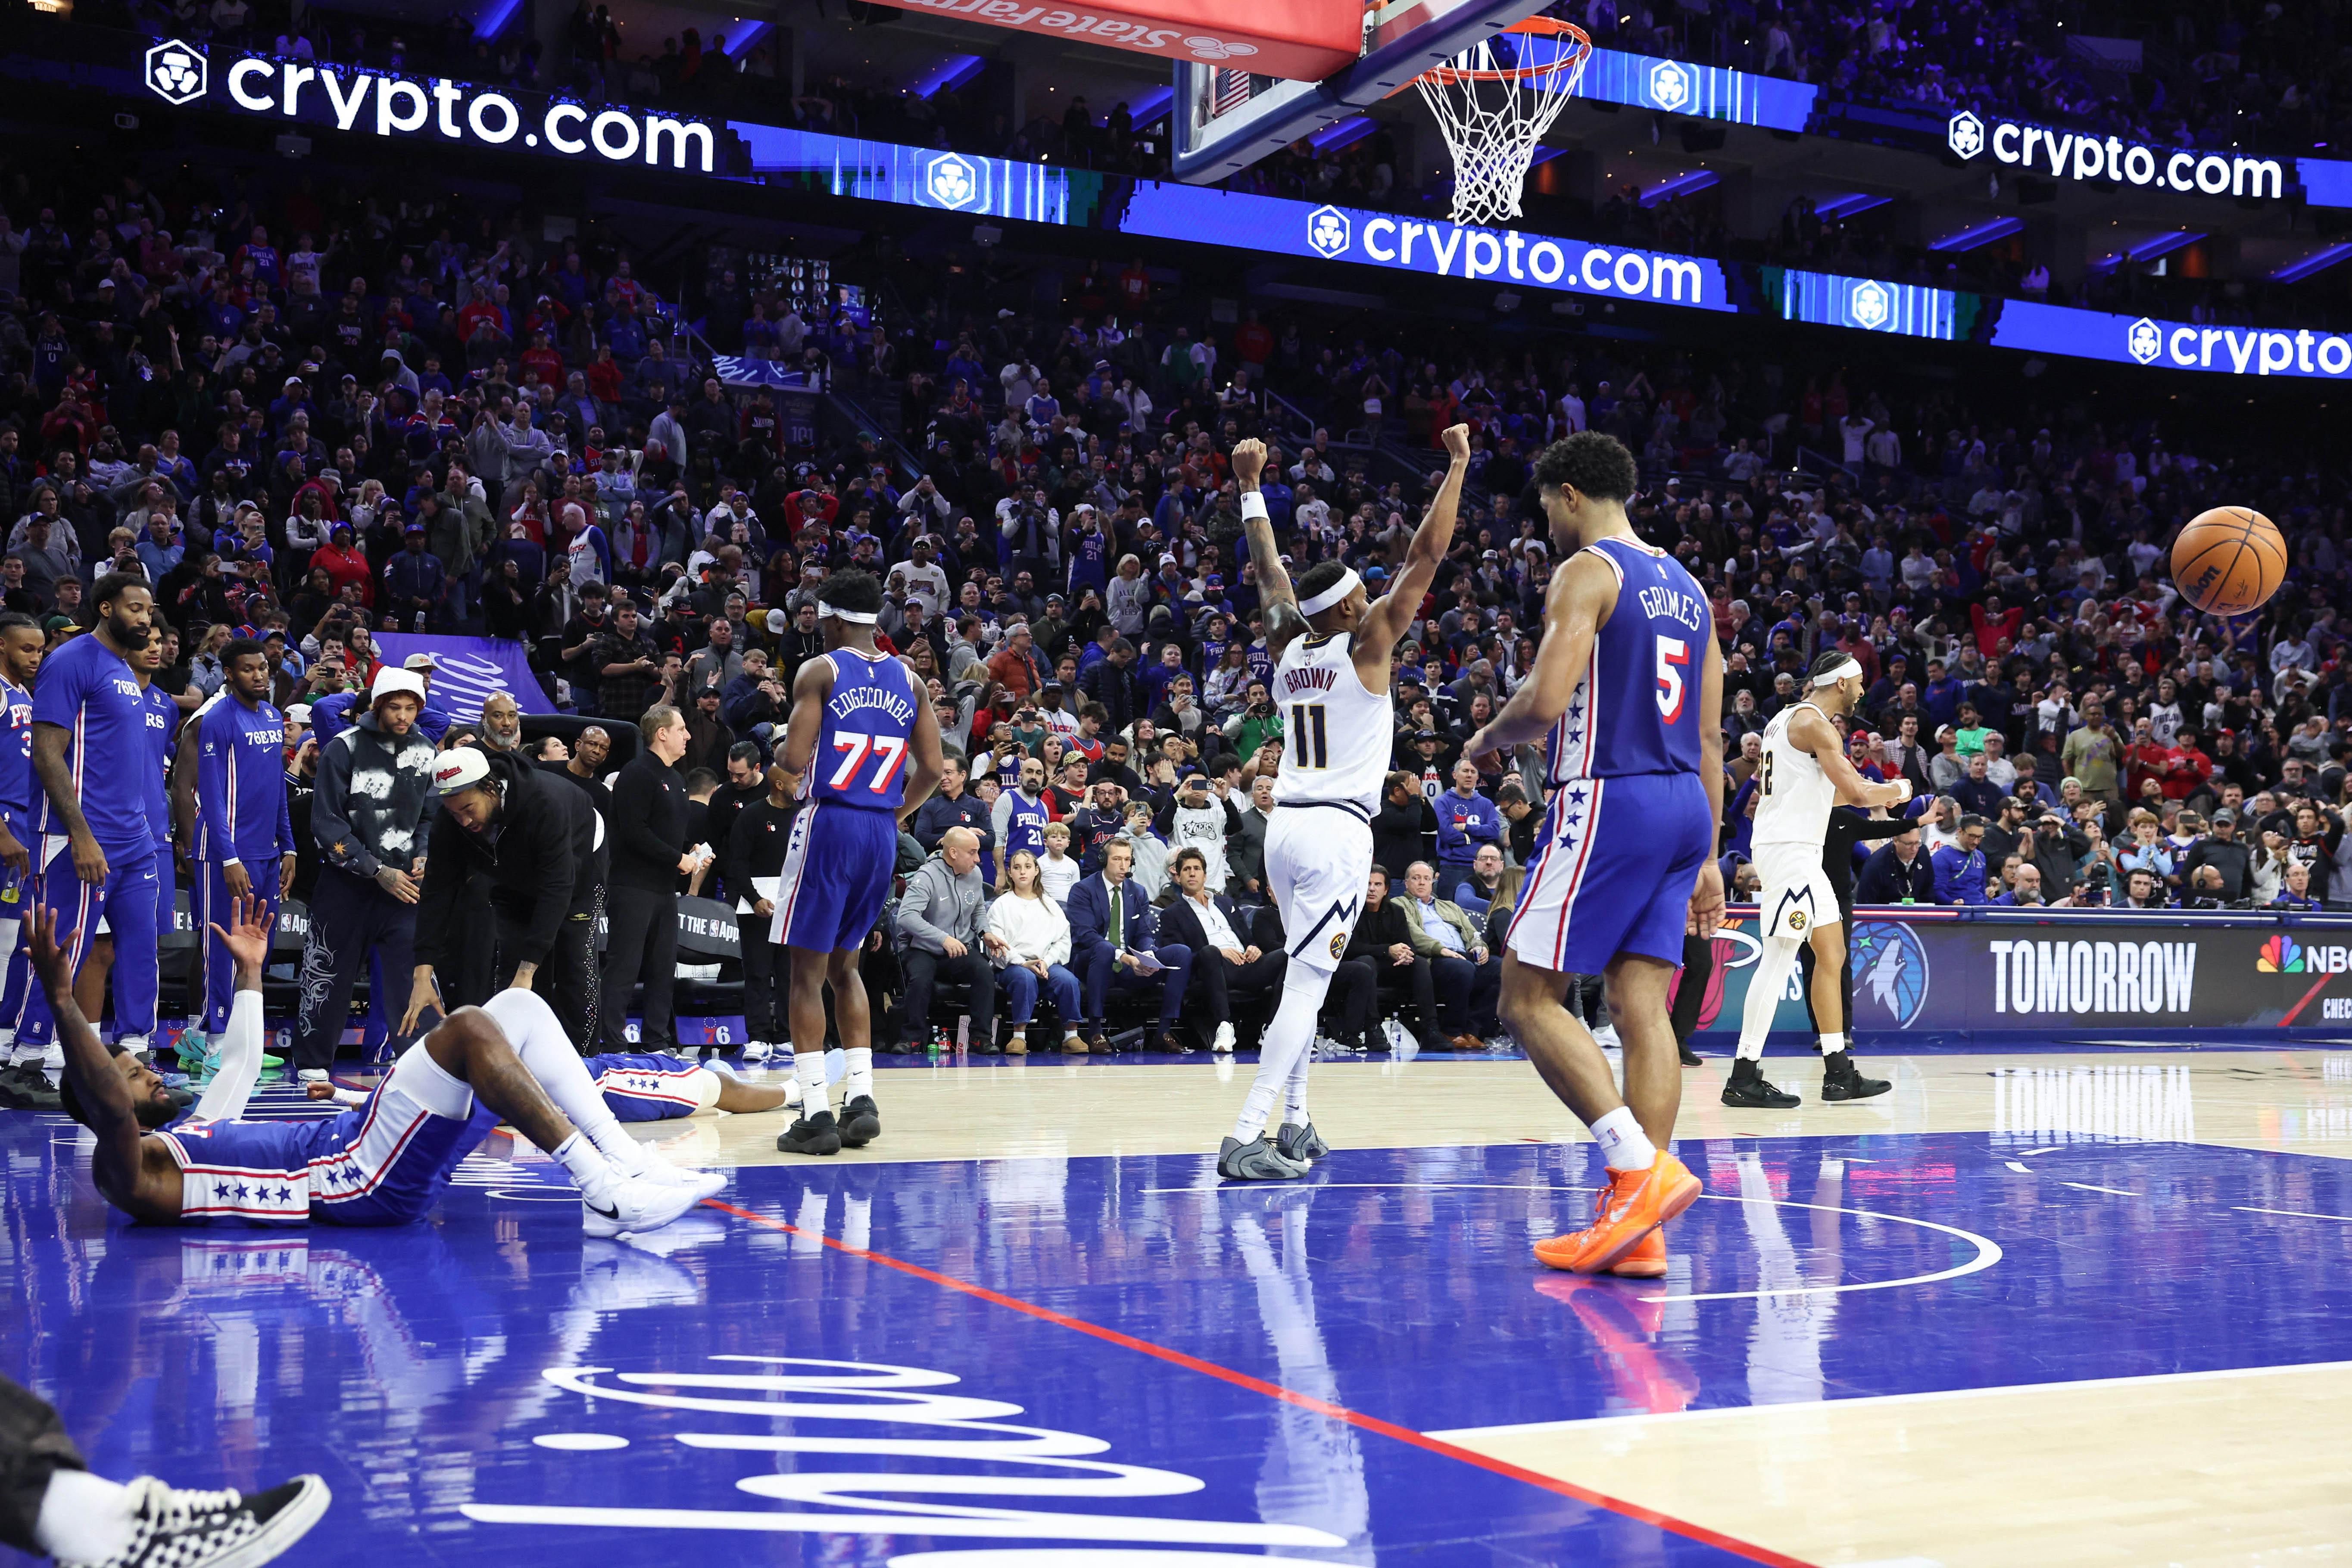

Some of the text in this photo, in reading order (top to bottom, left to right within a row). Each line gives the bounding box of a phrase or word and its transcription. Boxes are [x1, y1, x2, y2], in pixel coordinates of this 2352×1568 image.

[228, 58, 714, 172] crypto.com
[1993, 123, 2282, 199] crypto.com
[1363, 218, 1702, 303] crypto.com
[2169, 327, 2352, 376] crypto
[791, 426, 814, 442] 101
[1086, 550, 1097, 561] 21
[1638, 586, 1703, 632] GRIMES
[1247, 652, 1272, 664] PHILA
[1252, 664, 1268, 675] 77
[1284, 668, 1338, 695] BROWN
[1656, 634, 1690, 725] 5
[828, 686, 914, 727] EDGECOMBE
[245, 730, 283, 745] 76ERS
[1291, 703, 1328, 770] 11
[829, 730, 908, 794] 77
[1427, 783, 1436, 797] 0
[1017, 812, 1047, 829] PHILA
[1031, 829, 1043, 846] 21
[687, 915, 707, 935] THE
[719, 920, 739, 943] App
[1990, 939, 2197, 1015] TOMORROW
[704, 1025, 727, 1045] 76
